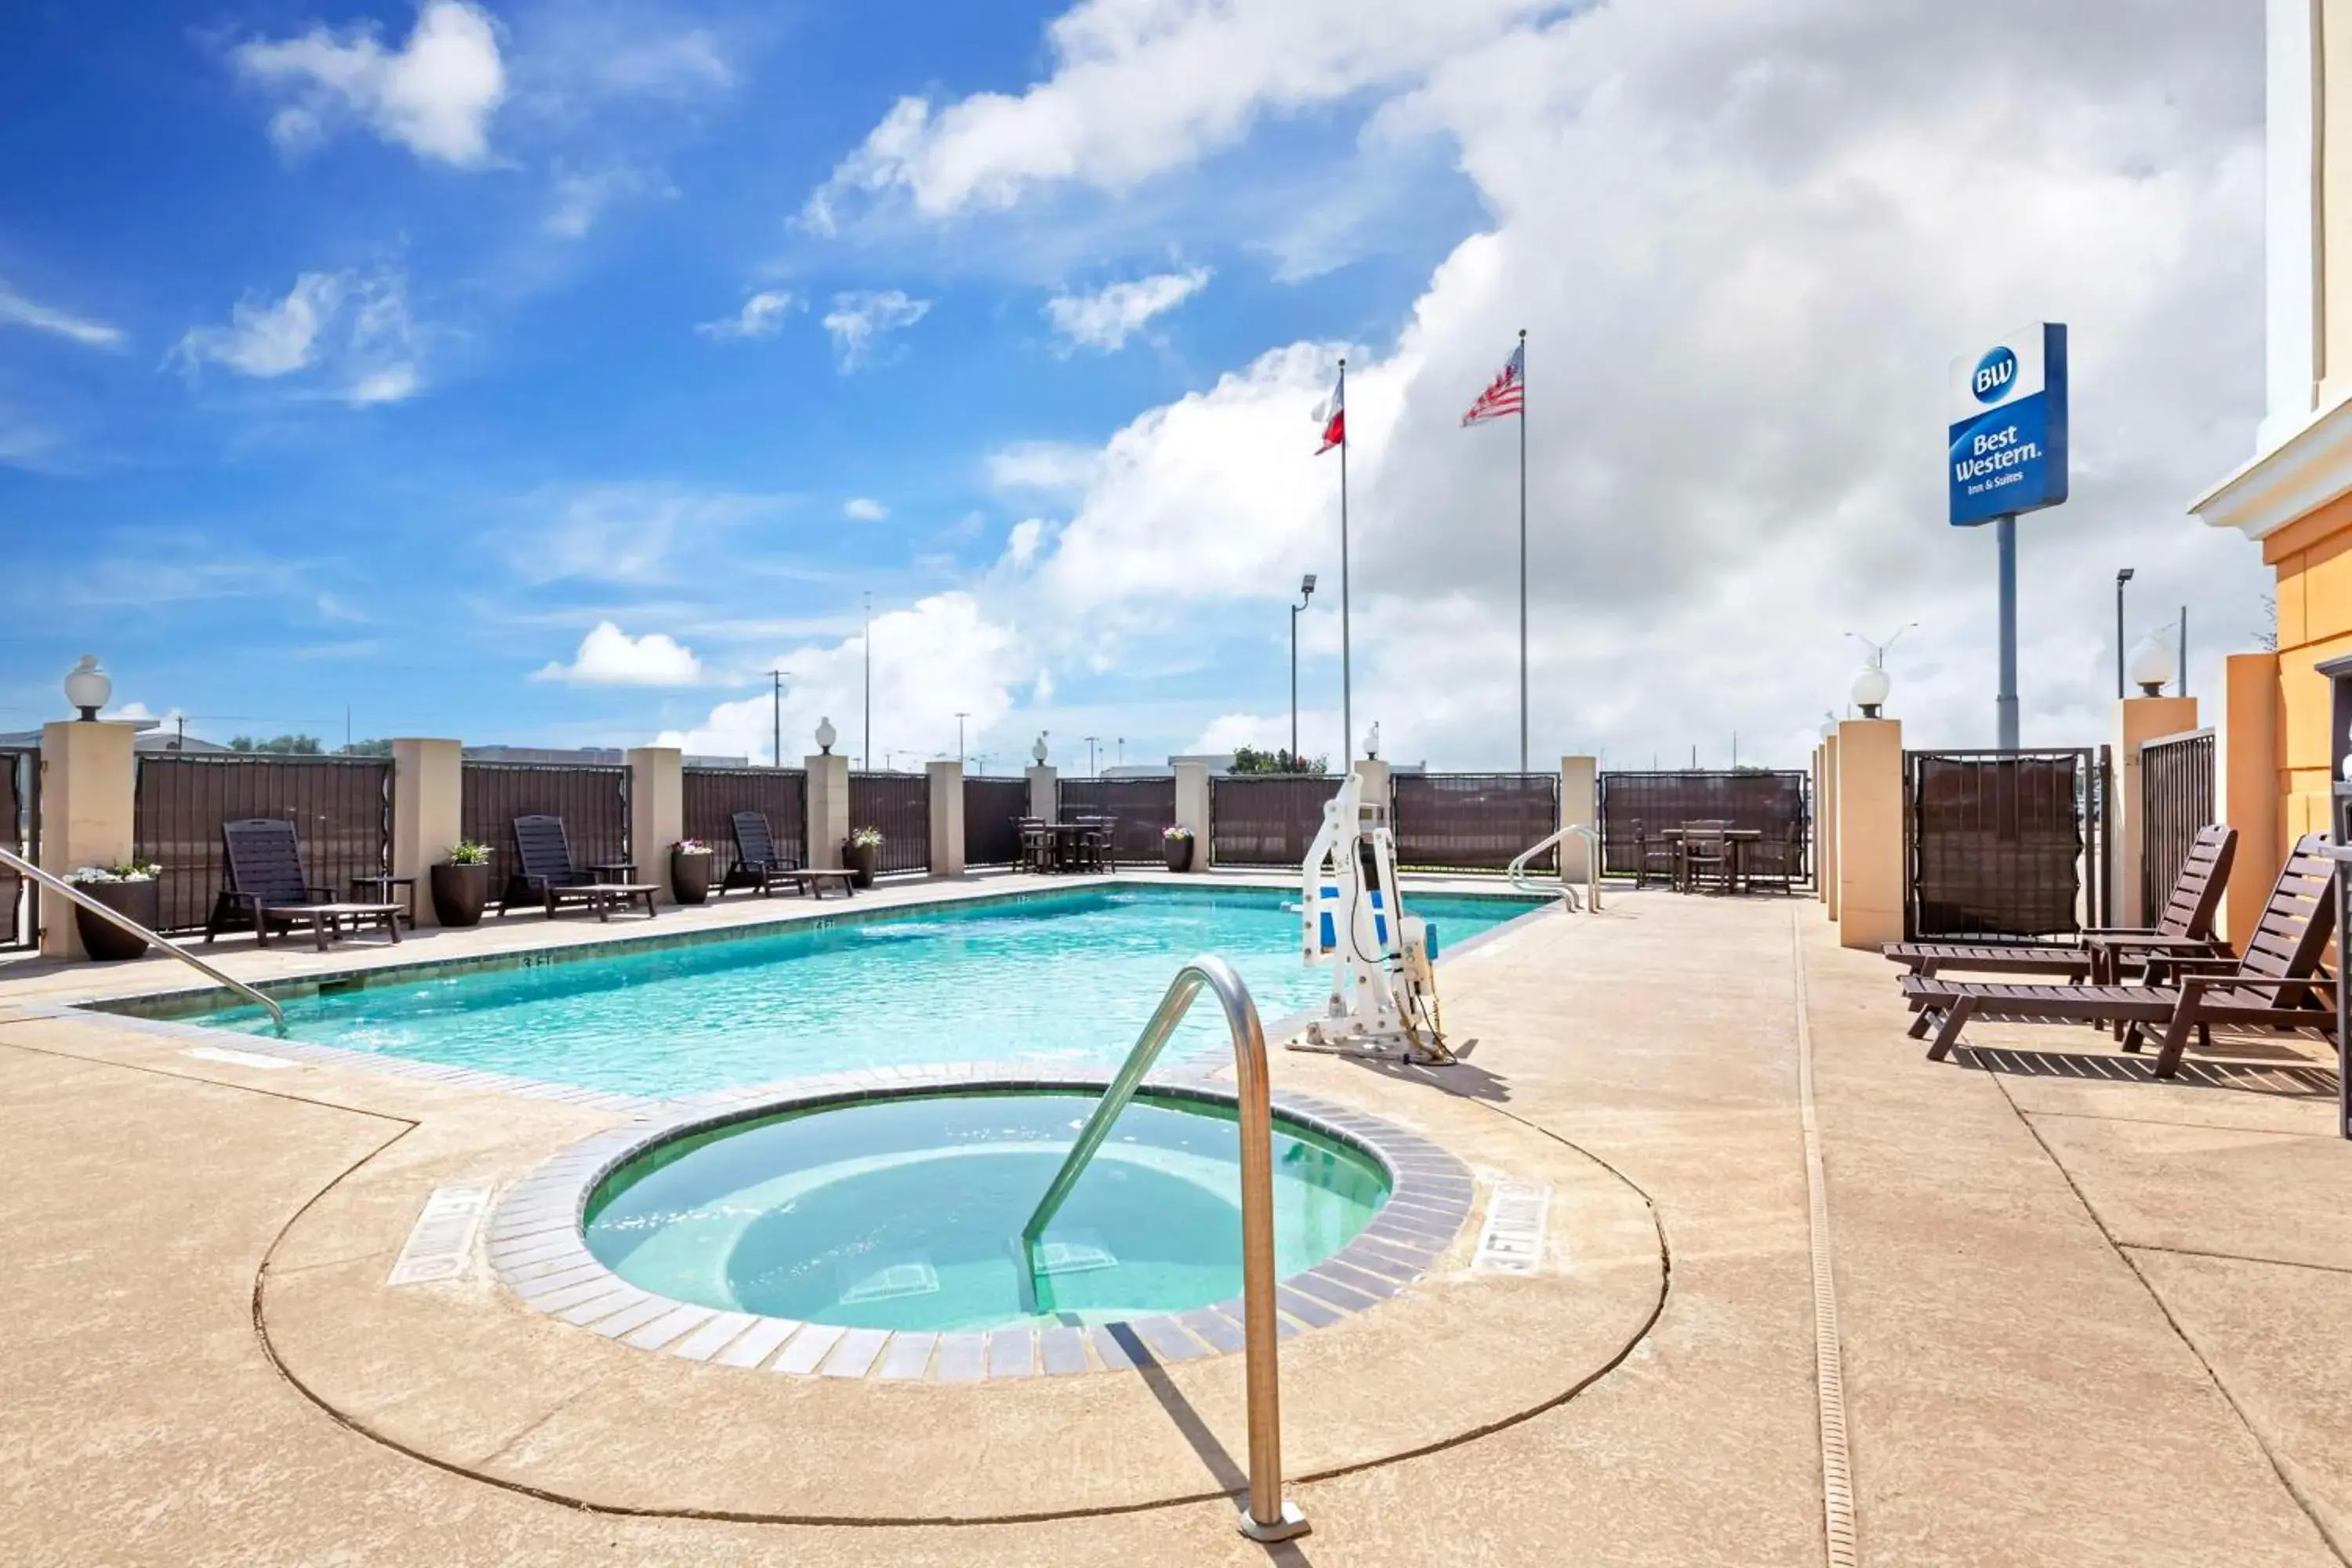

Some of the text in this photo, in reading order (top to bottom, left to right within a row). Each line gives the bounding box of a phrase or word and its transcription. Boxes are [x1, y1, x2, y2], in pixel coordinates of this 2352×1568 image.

[1976, 358, 2013, 393] BW
[1974, 426, 2017, 456] Best
[1968, 471, 2024, 495] Inn & Suites
